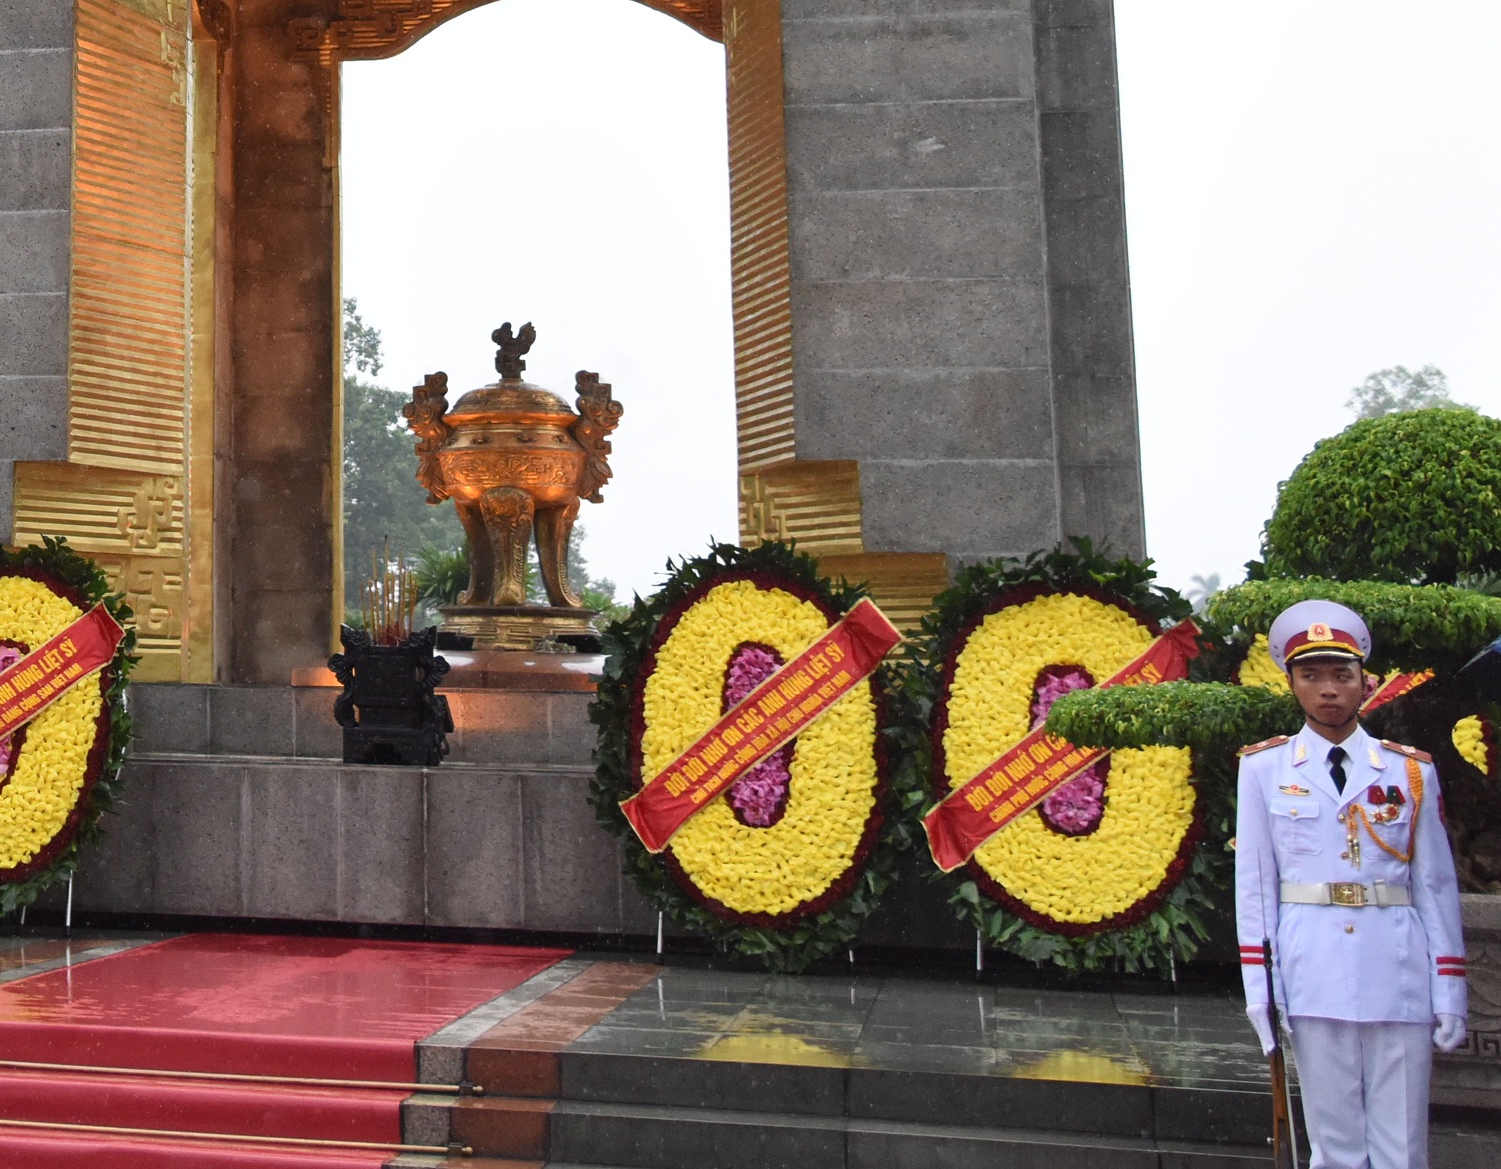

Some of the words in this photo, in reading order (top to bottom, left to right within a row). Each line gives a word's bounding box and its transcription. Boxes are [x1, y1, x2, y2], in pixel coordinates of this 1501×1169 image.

[11, 663, 44, 692] HÙNG
[38, 647, 64, 670] LIỆT
[59, 636, 77, 657] SỸ
[664, 773, 690, 798] ĐỜI
[681, 758, 708, 782] ĐỜI
[700, 735, 728, 766] NHỚ
[721, 726, 744, 746] ƠN
[736, 707, 765, 733] CÁC
[757, 691, 787, 717] ANH
[778, 675, 814, 700] HÙNG
[804, 655, 832, 679] LIỆT
[825, 640, 845, 662] SỸ
[964, 786, 994, 812] ĐỜI
[985, 771, 1013, 797] ĐỜI
[1004, 750, 1035, 782] NHỚ
[1029, 741, 1054, 763] ƠN
